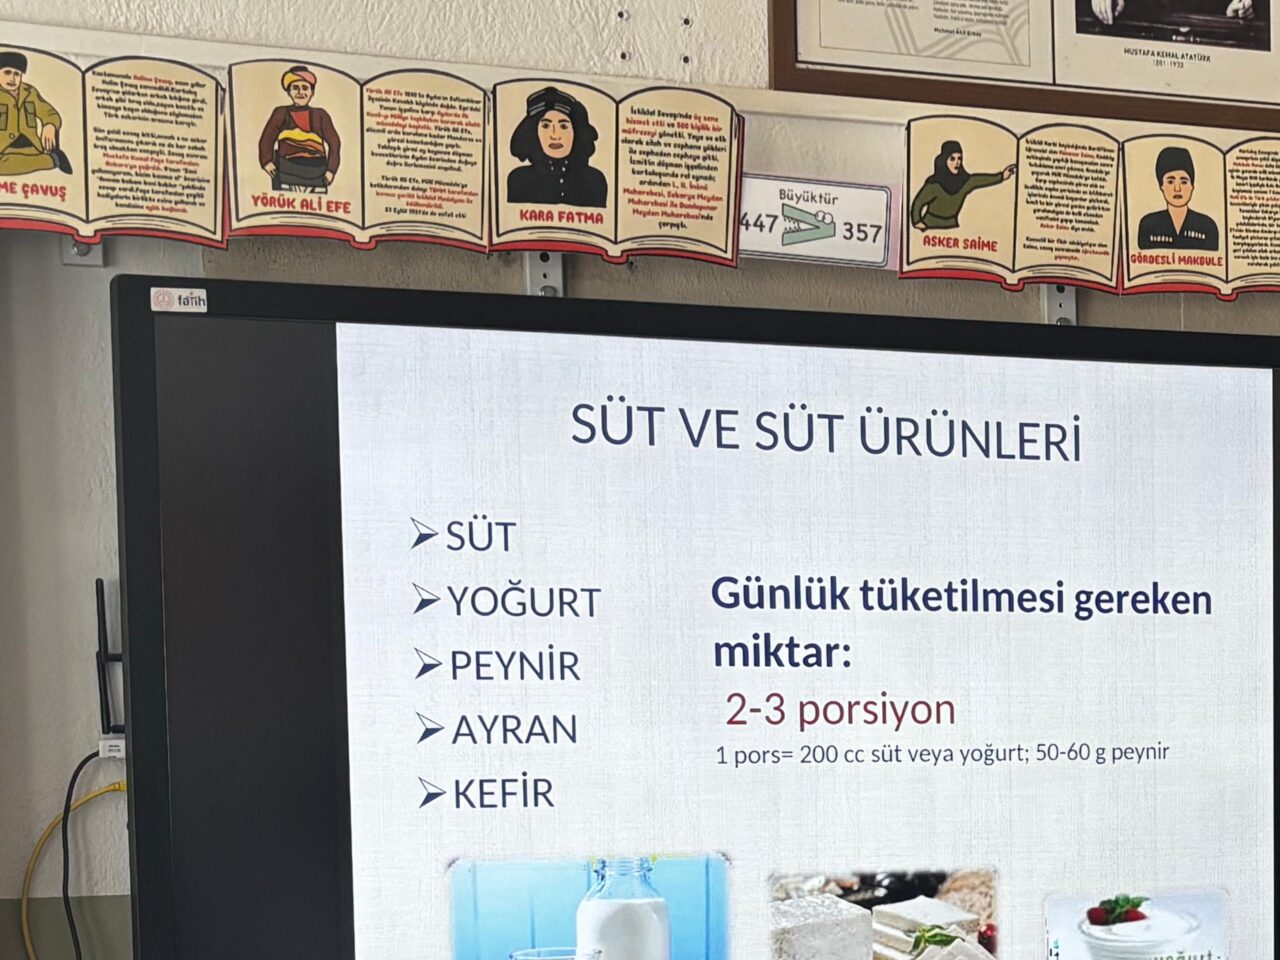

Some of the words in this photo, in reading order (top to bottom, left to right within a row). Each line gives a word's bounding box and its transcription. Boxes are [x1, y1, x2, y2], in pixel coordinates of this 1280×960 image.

[1124, 48, 1155, 56] MUSTAFA
[22, 183, 66, 202] ÇAVUŞ
[252, 192, 296, 210] YÖRÜK
[300, 196, 323, 212] ALİ
[326, 200, 351, 214] EFE
[779, 188, 838, 205] Büyüktür
[519, 208, 554, 223] KARA
[557, 210, 605, 225] FATMA
[740, 212, 779, 233] 447
[843, 222, 883, 243] 357
[923, 235, 959, 248] ASKER
[963, 236, 998, 252] SAİME
[1131, 252, 1175, 264] GÖRDESLİ
[1178, 255, 1223, 266] MAKBULE
[178, 291, 206, 306] fatih
[571, 394, 665, 446] SÜT
[678, 407, 740, 450] VE
[755, 402, 845, 453] SÜT
[859, 405, 1082, 462] ÜRÜNLERİ
[446, 514, 517, 552] SÜT
[447, 579, 602, 618] YOĞURT
[711, 574, 850, 611] Günlük
[859, 576, 1065, 615] tüketilmesi
[1074, 581, 1212, 621] gereken
[451, 643, 581, 681] PEYNİR
[714, 632, 851, 668] miktar:
[726, 692, 786, 726] 2-3
[799, 690, 956, 733] porsiyon
[451, 714, 577, 745] AYRAN
[716, 746, 728, 765] 1
[734, 748, 793, 770] pors=
[800, 744, 839, 764] 200
[844, 748, 865, 763] cc
[871, 744, 903, 763] süt
[907, 748, 955, 769] veya
[959, 743, 1030, 768] yoğurt;
[1035, 743, 1091, 762] 50-60
[1095, 748, 1106, 766] g
[1111, 741, 1170, 766] peynir
[454, 770, 555, 809] KEFİR
